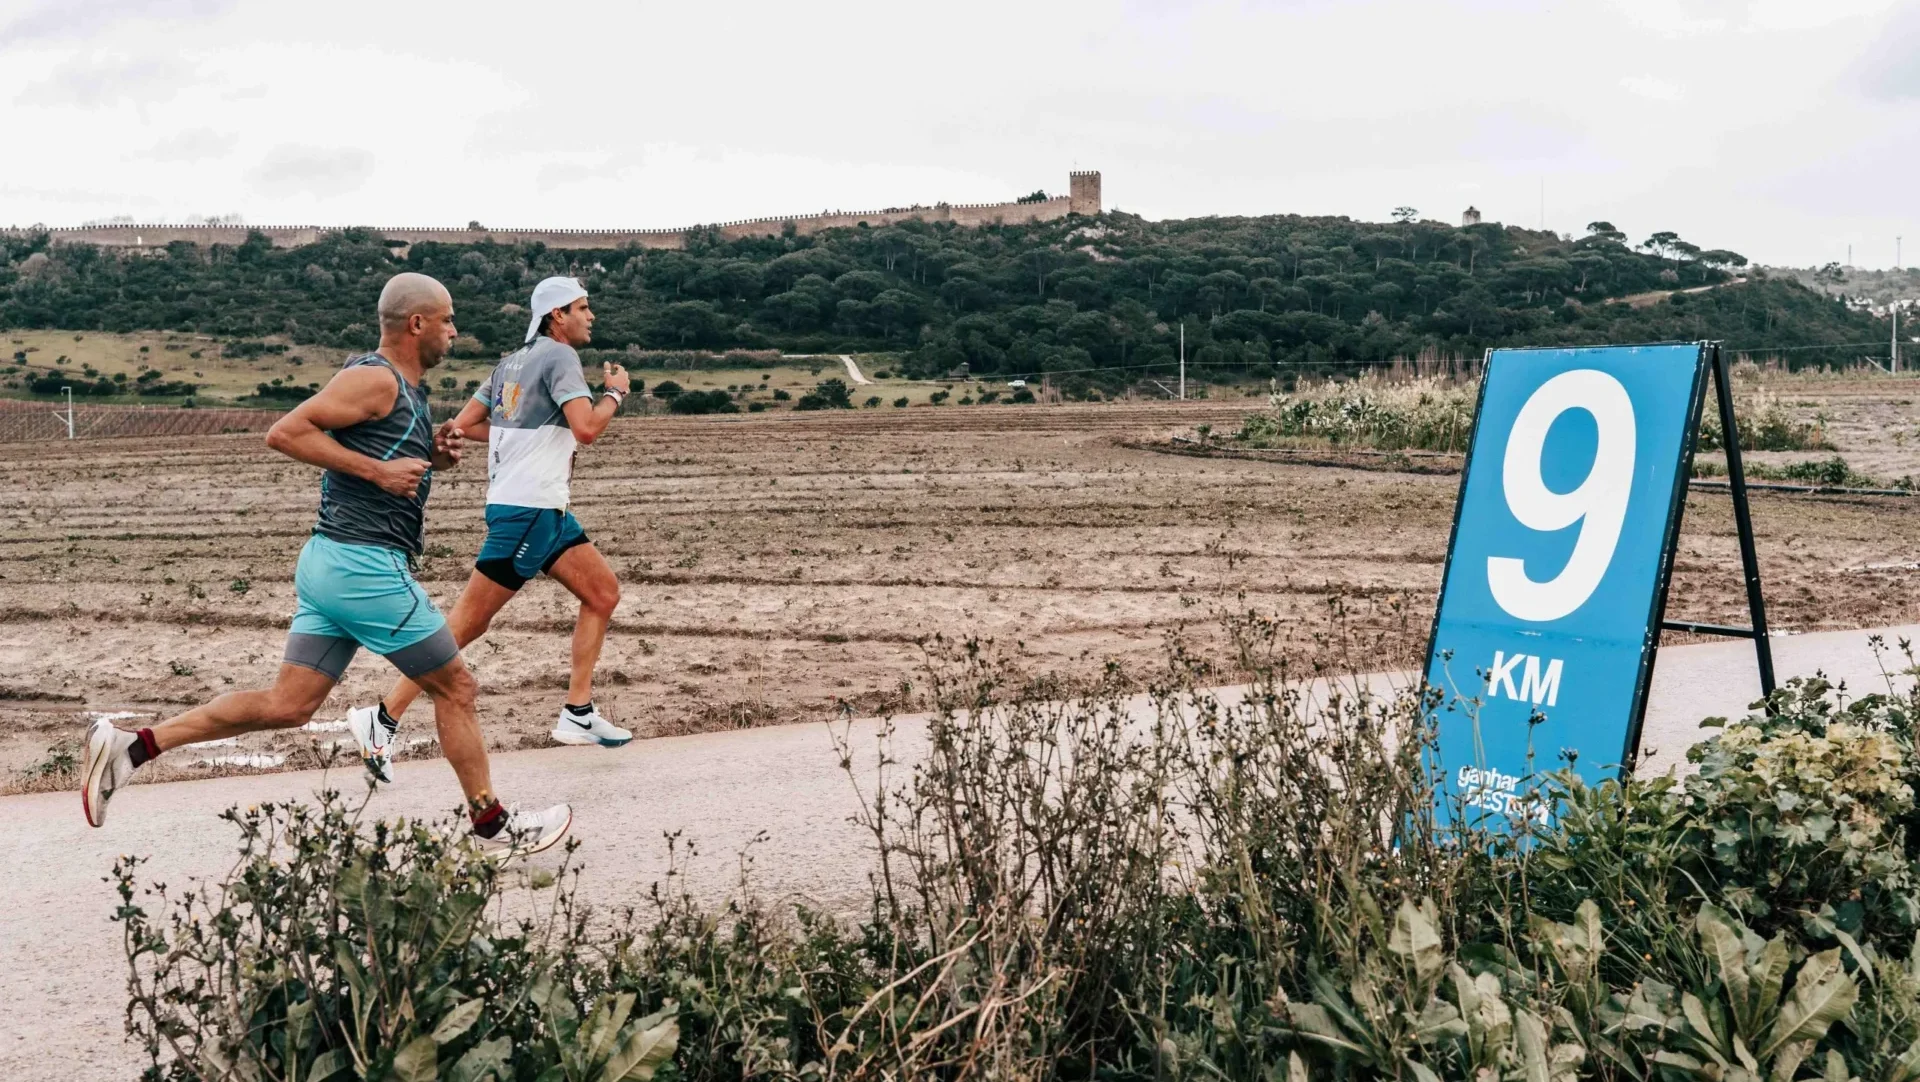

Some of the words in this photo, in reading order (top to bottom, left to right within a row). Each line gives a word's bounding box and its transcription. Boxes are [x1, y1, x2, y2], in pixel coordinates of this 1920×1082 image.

[1488, 369, 1636, 621] 9
[1488, 651, 1563, 706] KM
[1457, 765, 1521, 791] ganhar
